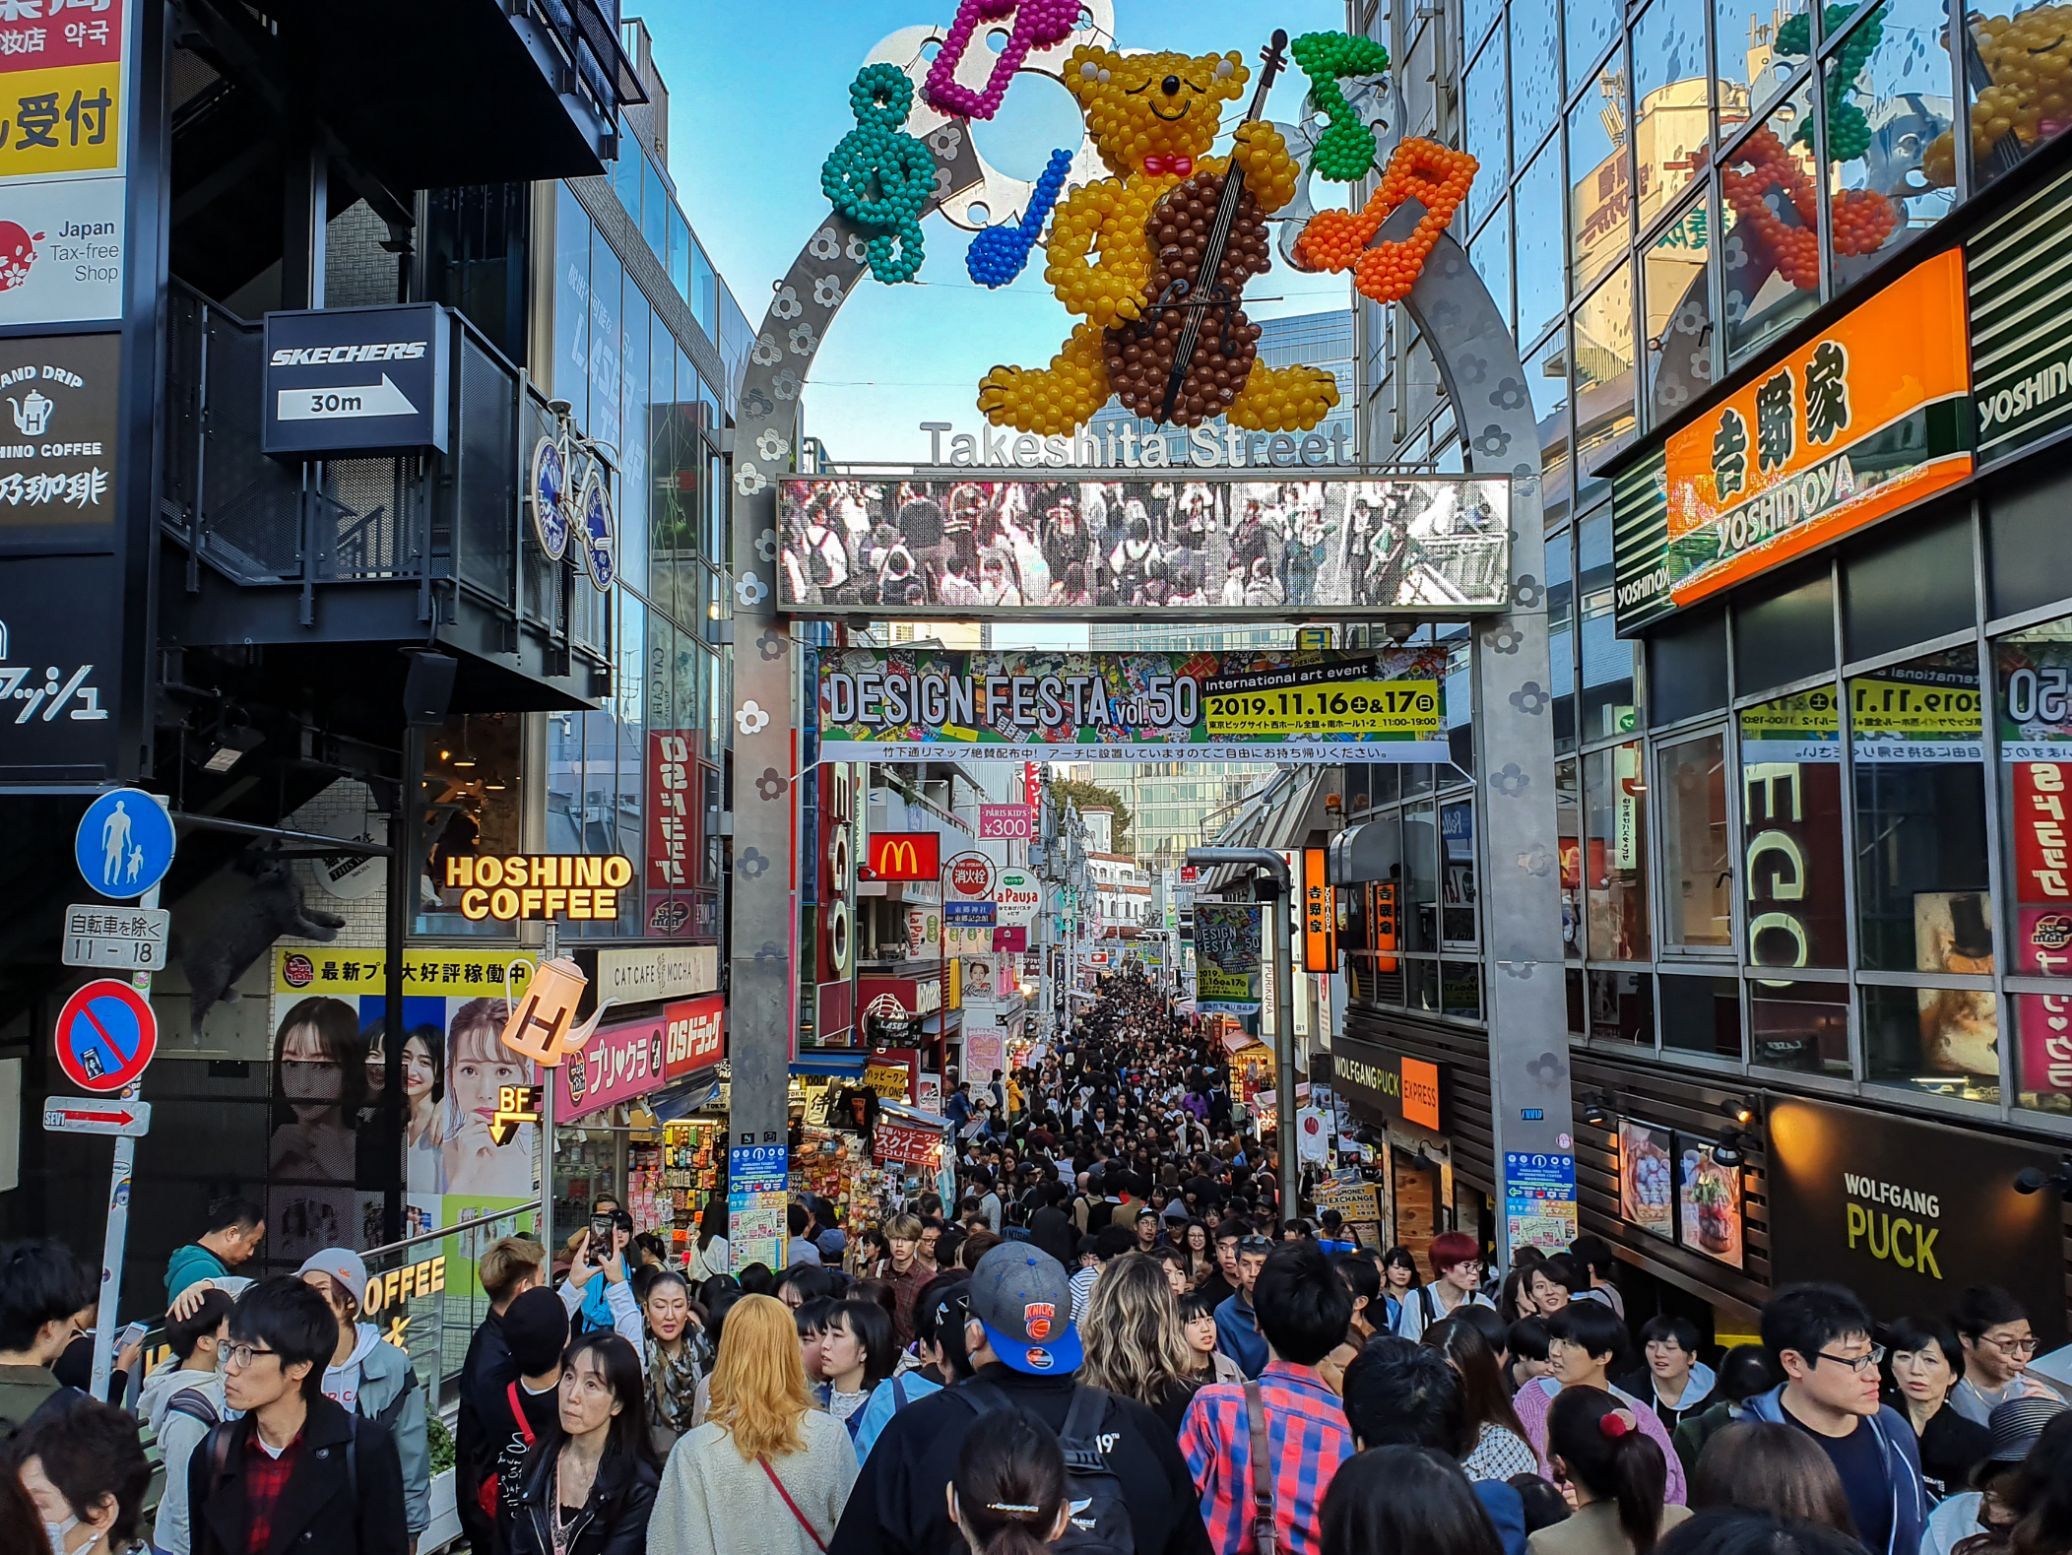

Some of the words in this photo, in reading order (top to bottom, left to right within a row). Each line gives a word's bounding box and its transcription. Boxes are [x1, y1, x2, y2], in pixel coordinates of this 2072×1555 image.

[64, 20, 110, 48] 약국
[59, 221, 115, 240] Japan
[50, 243, 119, 261] Tax-free
[75, 265, 118, 284] Shop
[270, 342, 428, 367] SKECHERS
[0, 366, 37, 391] AND
[42, 365, 84, 388] DRIP
[311, 394, 362, 413] 30m
[1711, 341, 1850, 503] 吉野家
[40, 442, 102, 457] COFFEE
[920, 422, 1168, 468] Takeshita
[1190, 421, 1351, 468] Street
[1716, 453, 1855, 558] YOSHINOYA
[1205, 674, 1296, 692] International
[1300, 670, 1324, 682] art
[1327, 663, 1368, 679] event
[828, 673, 974, 725] DESIGN
[985, 673, 1111, 725] FESTA
[985, 819, 1027, 836] ¥300
[447, 856, 633, 887] HOSHINO
[954, 870, 986, 885] 消火栓
[460, 888, 617, 920] COFFEE
[1005, 888, 1039, 905] Pausa
[71, 914, 161, 938] 自転車を除く
[1196, 927, 1237, 943] DESIGN
[75, 939, 93, 960] 11
[133, 942, 152, 962] 18
[1198, 938, 1233, 953] FESTA
[321, 960, 526, 986] 最新プ大好評稼働中
[1264, 966, 1274, 1015] PURIKURA
[667, 1011, 723, 1065] OSドラッグ
[1333, 1055, 1376, 1090] WOLFGANG
[1376, 1068, 1400, 1098] PUCK
[499, 1086, 530, 1113] BF
[889, 1086, 905, 1097] ONE
[1404, 1080, 1436, 1108] EXPRESS
[875, 1147, 937, 1163] SQUEEZE
[1328, 1195, 1375, 1205] EXCHANGE
[1843, 1172, 1940, 1218] WOLFGANG
[1847, 1202, 1943, 1280] PUCK
[364, 1256, 446, 1316] OFFEE
[1025, 1303, 1055, 1319] KNICKS
